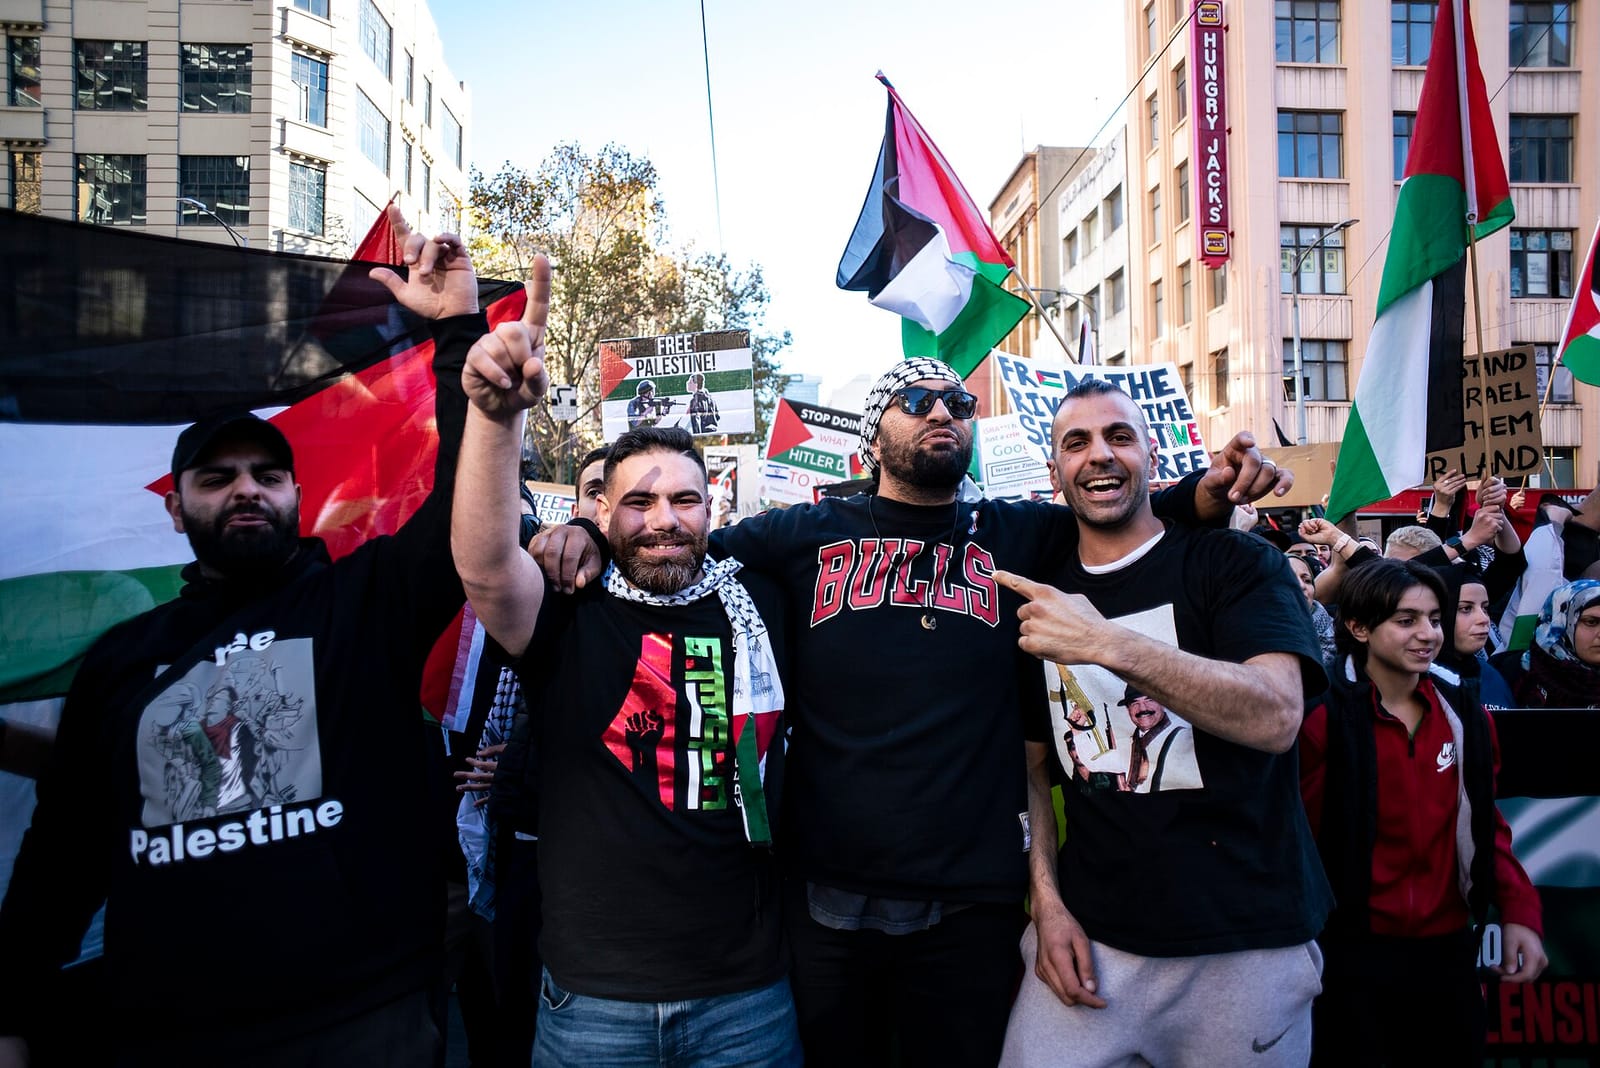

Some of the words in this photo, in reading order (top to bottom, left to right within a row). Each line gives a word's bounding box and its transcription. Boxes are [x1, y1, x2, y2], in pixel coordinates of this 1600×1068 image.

[1203, 32, 1219, 130] HUNGRY
[1206, 138, 1224, 223] JACK'S
[657, 334, 693, 355] FREE
[635, 352, 717, 378] PALESTINE!
[1104, 367, 1177, 400] THE
[1466, 381, 1531, 409] RAEL
[801, 408, 831, 424] STOP
[831, 416, 861, 431] DOIN
[1008, 387, 1060, 418] RIV
[1141, 398, 1193, 422] THE
[820, 434, 848, 447] WHAT
[1020, 414, 1052, 446] SE
[1150, 422, 1203, 449] TINE
[789, 447, 833, 470] HITLER
[1157, 449, 1205, 481] REE
[789, 471, 810, 487] TO
[533, 493, 561, 510] REE
[810, 538, 1000, 628] BULLS
[214, 630, 276, 667] ree
[131, 799, 344, 866] Palestine
